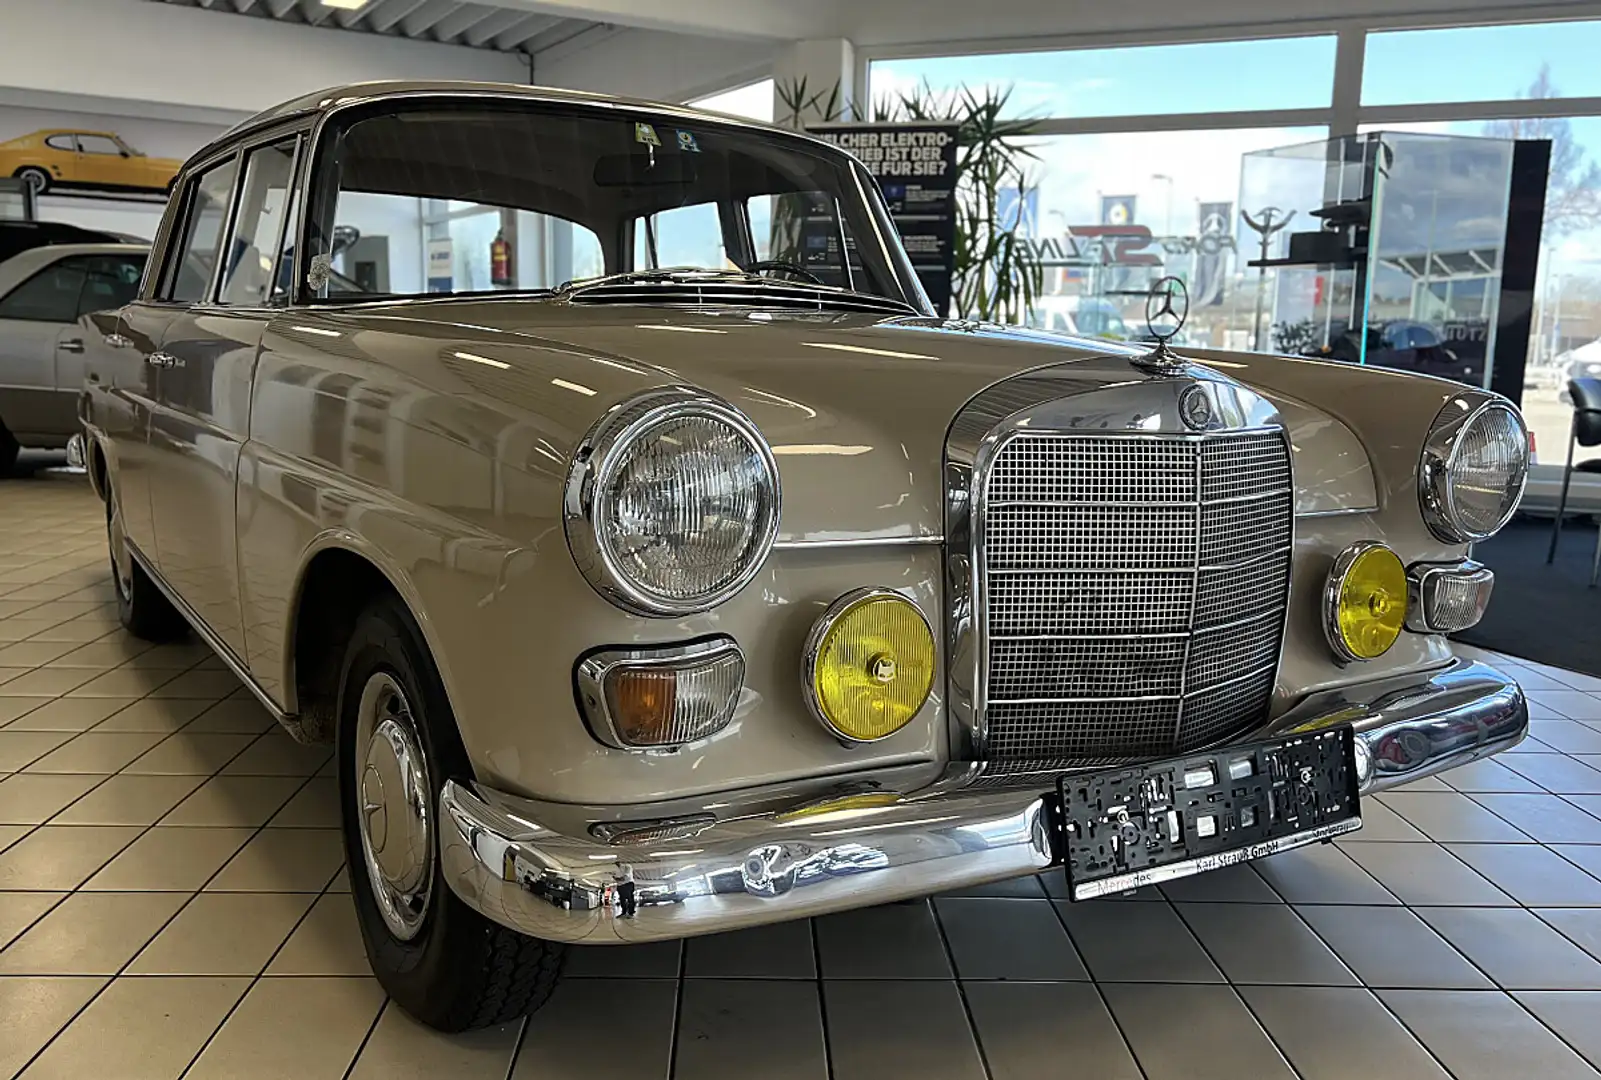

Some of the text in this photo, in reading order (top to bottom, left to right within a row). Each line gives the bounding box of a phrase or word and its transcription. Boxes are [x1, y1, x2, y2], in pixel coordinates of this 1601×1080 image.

[881, 131, 953, 147] ELEKTRO-
[885, 147, 909, 161] IST
[911, 147, 941, 161] DER
[913, 161, 948, 175] SIE?
[1250, 841, 1279, 858] GmbH
[1097, 873, 1152, 894] Mercedes
